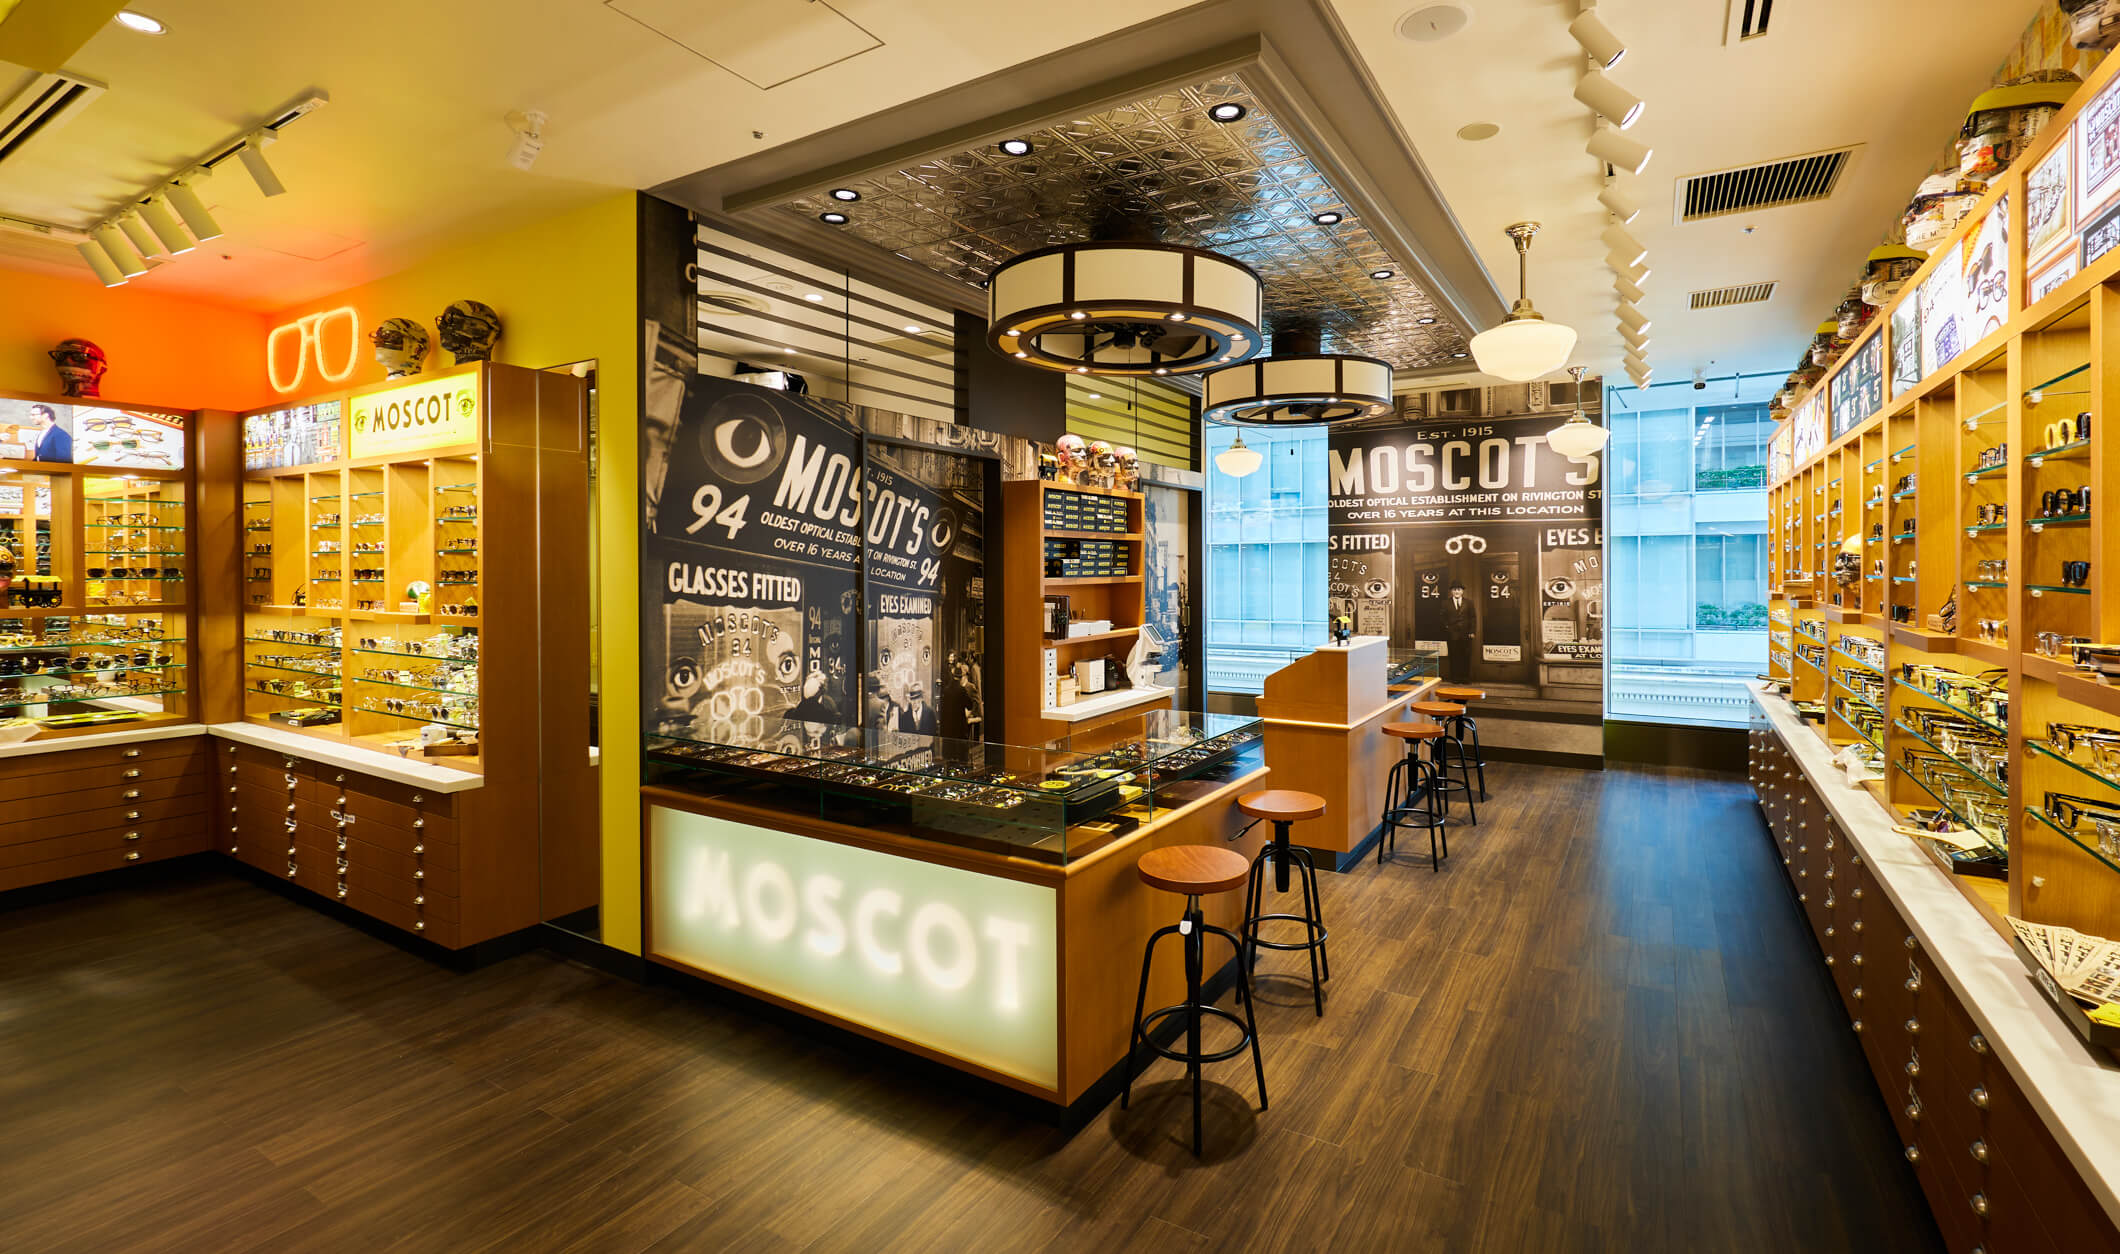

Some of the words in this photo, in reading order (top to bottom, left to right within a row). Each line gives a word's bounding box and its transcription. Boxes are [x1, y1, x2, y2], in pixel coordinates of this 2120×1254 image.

[372, 391, 452, 433] MOSCOT
[1462, 426, 1494, 438] 1915
[1328, 434, 1601, 497] MOSCOTS
[876, 471, 894, 487] 1915
[685, 484, 751, 540] 94
[1328, 498, 1364, 509] OLDEST
[1366, 496, 1409, 507] OPTICAL
[1411, 493, 1498, 505] ESTABLISHMENT
[1502, 492, 1518, 502] ON
[1522, 490, 1584, 502] RIVINGTON
[1347, 510, 1381, 520] OVER
[1384, 509, 1396, 519] 16
[1399, 508, 1445, 518] YEARS
[1448, 507, 1465, 517] AT
[1468, 507, 1501, 516] THIS
[1506, 505, 1585, 515] LOCATION
[760, 511, 801, 533] OLDEST
[800, 522, 834, 542] OPTICAL
[1546, 528, 1590, 547] EYES
[774, 537, 804, 554] OVER
[807, 542, 818, 556] 16
[821, 548, 852, 564] YEARS
[1341, 534, 1390, 551] FITTED
[668, 561, 749, 600] GLASSES
[752, 572, 802, 603] FITTED
[870, 566, 907, 583] LOCATION
[917, 557, 941, 587] 94
[880, 594, 899, 613] EYES
[900, 595, 932, 615] EXAMINED
[697, 613, 781, 647] MOSCOT'S
[808, 606, 821, 630] 94
[1557, 645, 1577, 653] EYES
[702, 659, 767, 692] MOSCOT'S
[679, 843, 1032, 1012] MOSCOT
